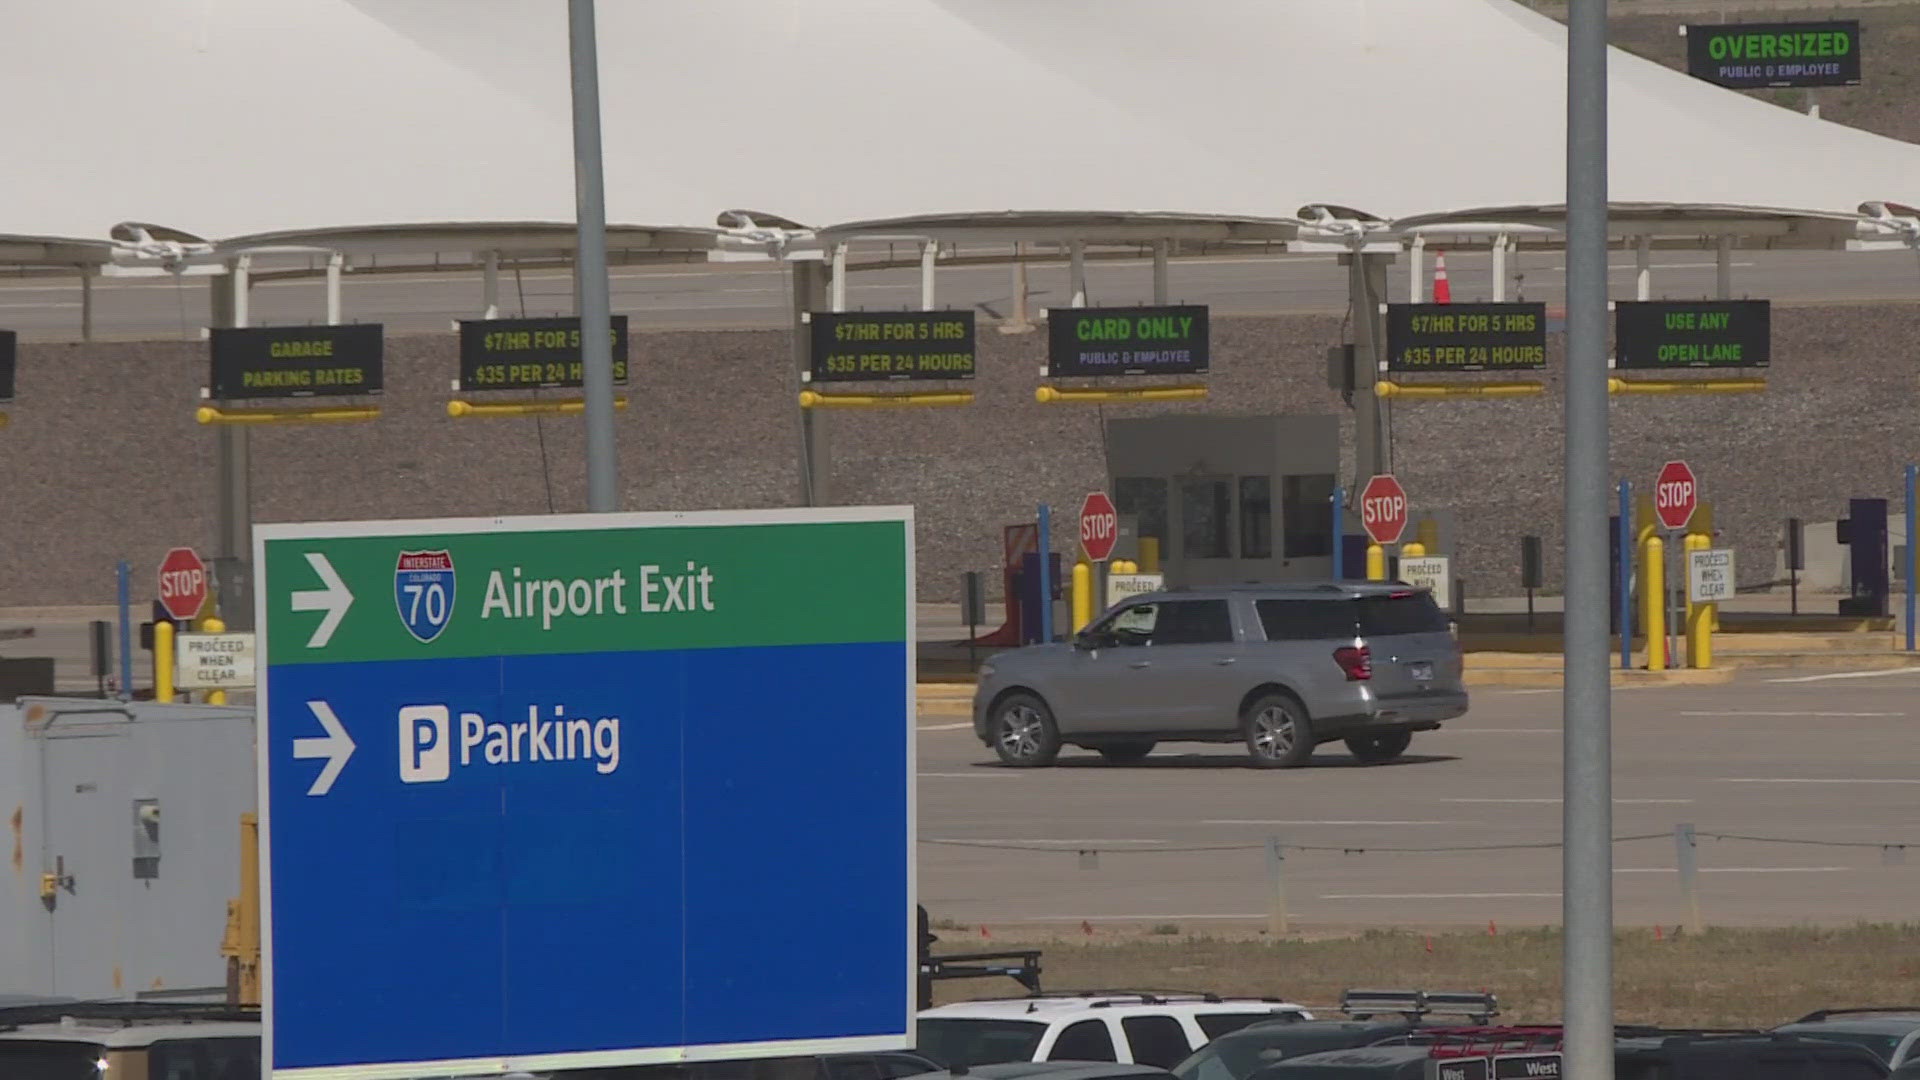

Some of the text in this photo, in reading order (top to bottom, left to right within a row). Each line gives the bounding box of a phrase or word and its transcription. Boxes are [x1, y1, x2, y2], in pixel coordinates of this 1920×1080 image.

[1708, 32, 1850, 60] OVERSIZED
[1719, 65, 1761, 78] PUBLIC
[1778, 63, 1840, 76] EMPLOYEE
[1077, 317, 1192, 341] CARD ONLY
[1411, 315, 1536, 334] $7/HR FOR 5 HRS
[1665, 313, 1730, 330] USE ANY
[484, 330, 580, 350] $7/HR FOR 5
[835, 322, 964, 341] $7/HR FOR 5 HRS
[270, 340, 333, 358] GARAGE
[1080, 352, 1119, 365] PUBLIC
[1134, 350, 1190, 363] EMPLOYEE
[1404, 346, 1544, 366] $35 PER 24 HOURS
[1658, 344, 1742, 361] OPEN LANE
[827, 353, 973, 373] $35 PER 24 HOURS
[243, 369, 363, 387] PARKING RATES
[476, 365, 505, 384] $35
[509, 364, 542, 383] PER
[546, 362, 566, 381] 24
[1659, 481, 1692, 508] STOP
[1365, 496, 1403, 523] STOP
[1082, 513, 1114, 540] STOP
[403, 556, 446, 569] INTERSTATE
[1695, 552, 1729, 567] PROCEED
[1407, 564, 1441, 576] PROCEED
[1702, 569, 1723, 581] WHEN
[161, 569, 202, 598] STOP
[1115, 581, 1154, 593] PROCEED
[1701, 582, 1725, 596] CLEAR
[404, 583, 446, 626] 70
[481, 561, 715, 630] Airport Exit
[189, 641, 244, 653] PROCEED
[200, 655, 234, 666] WHEN
[197, 669, 236, 681] CLEAR
[460, 705, 619, 774] Parking
[1443, 1068, 1465, 1080] West
[1527, 1061, 1558, 1076] West
